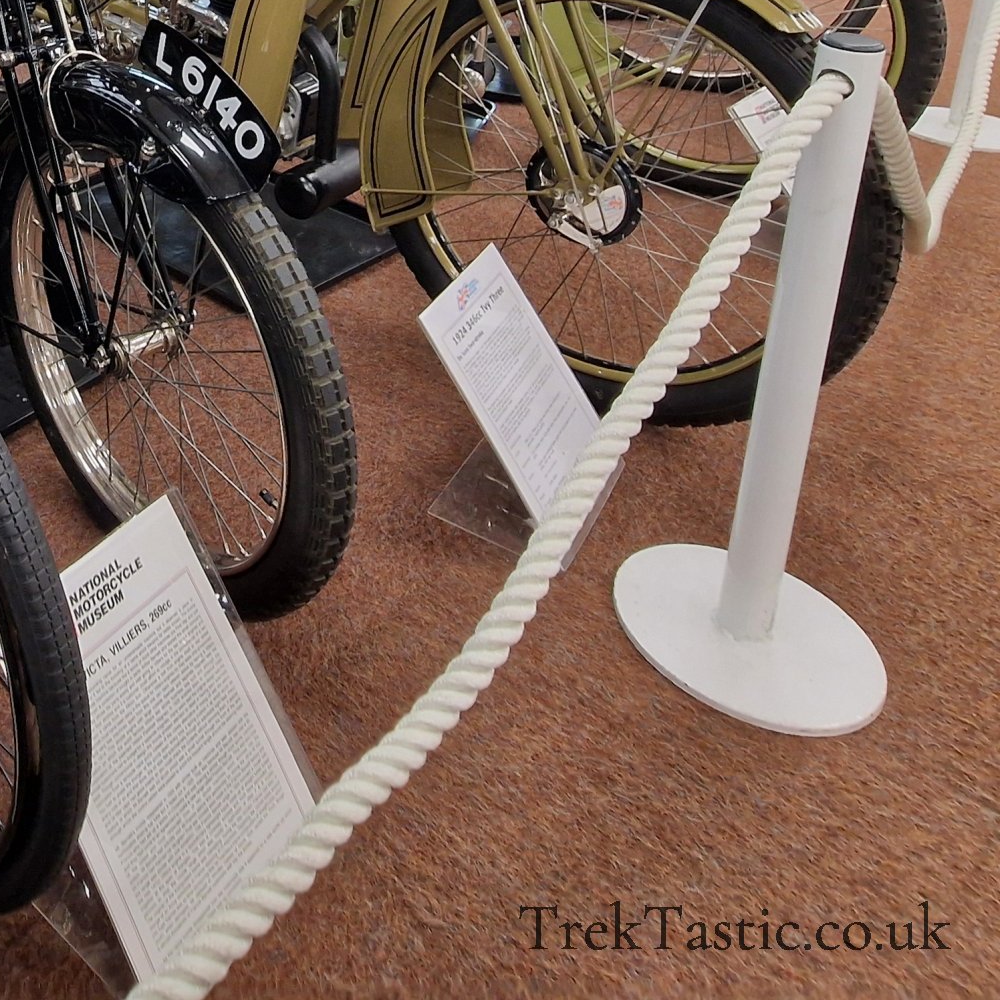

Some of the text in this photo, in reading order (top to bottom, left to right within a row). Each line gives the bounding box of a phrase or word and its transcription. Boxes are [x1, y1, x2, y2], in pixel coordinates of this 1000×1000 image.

[452, 325, 468, 346] 1924
[69, 559, 122, 607] NATIONAL
[73, 556, 144, 621] MOTORCYCLE
[77, 589, 125, 635] MUSEUM
[85, 599, 172, 679] ICTA, VILLIERS, 269cc
